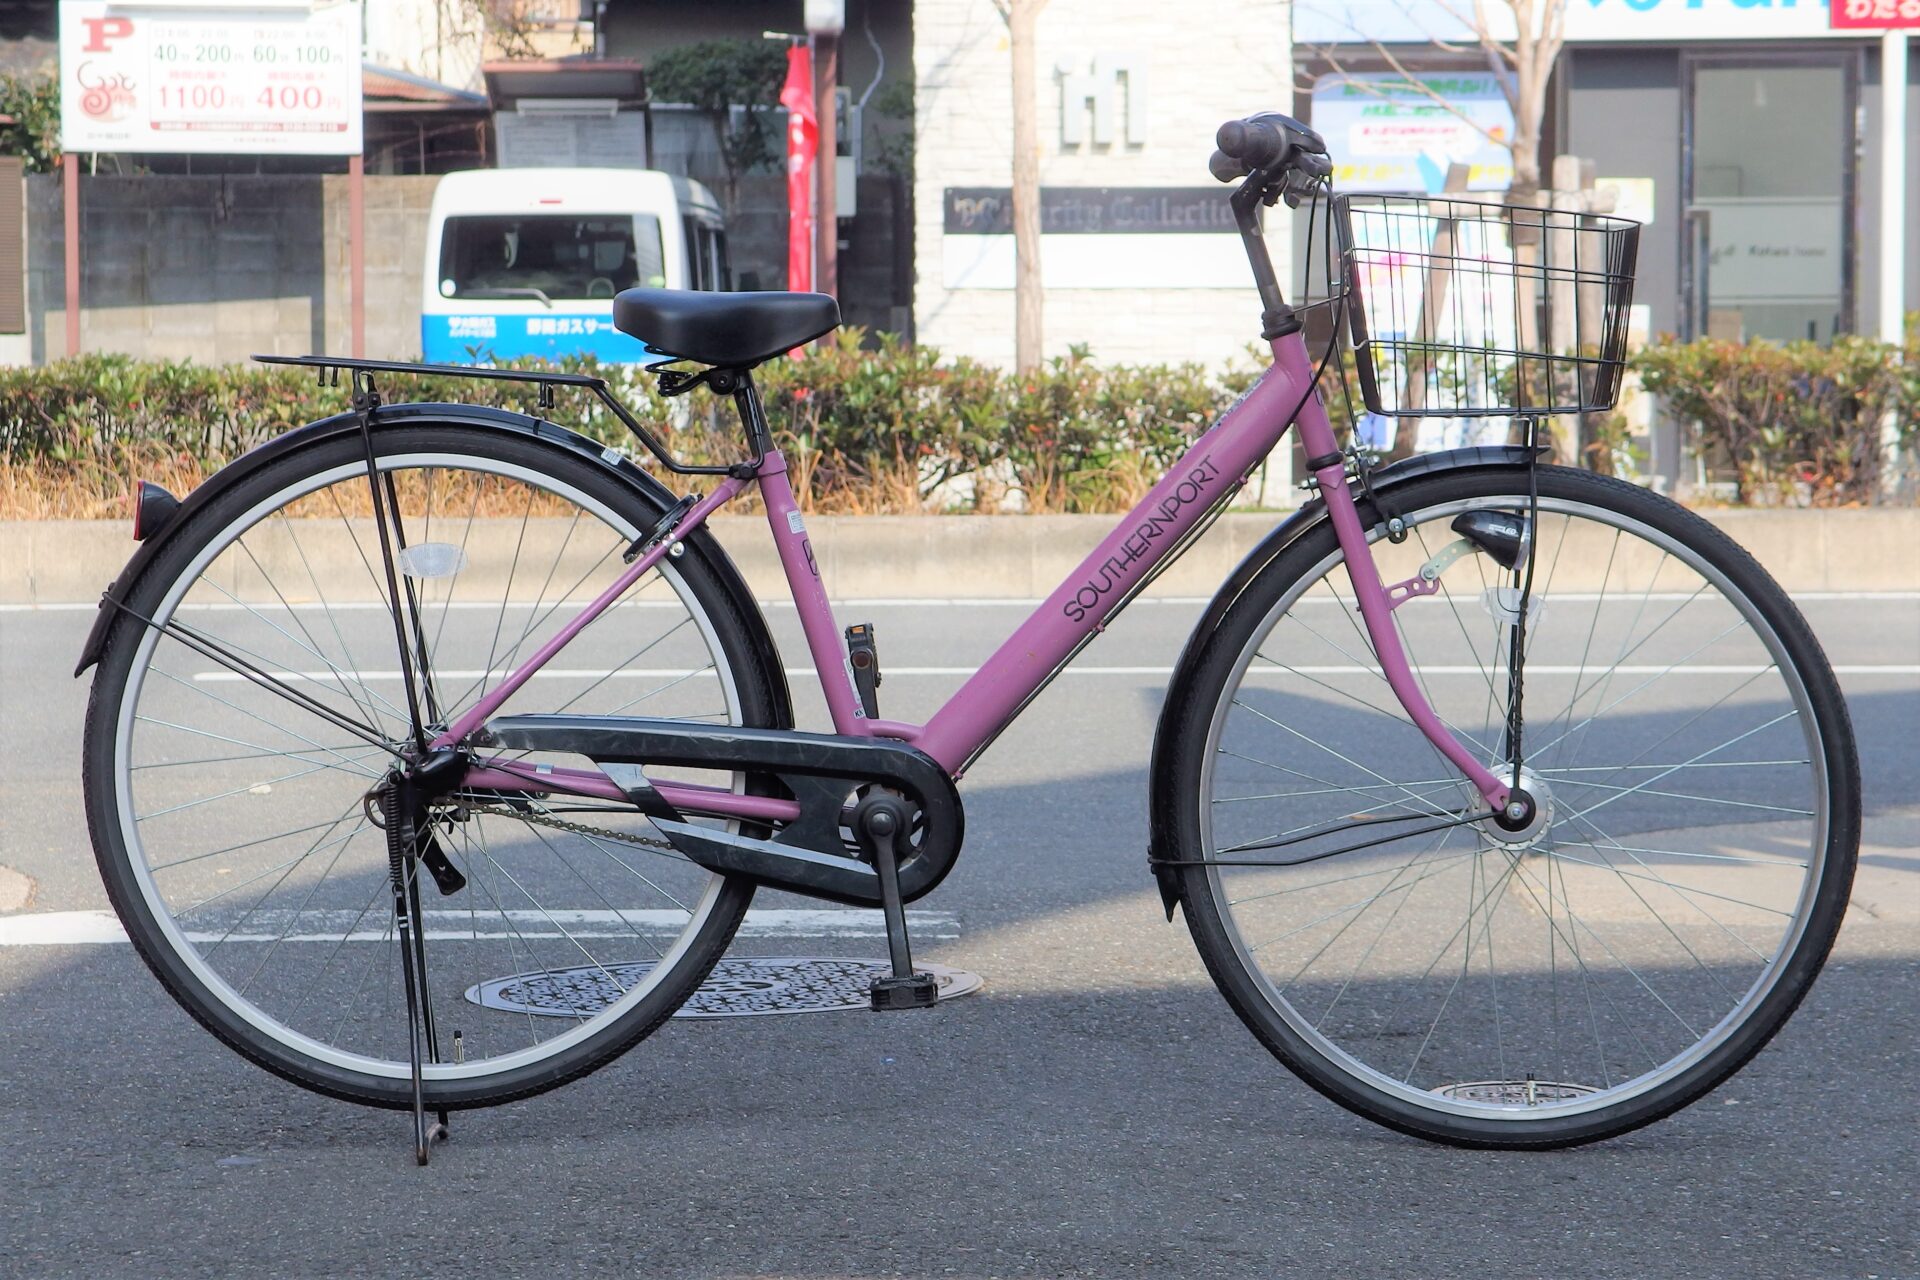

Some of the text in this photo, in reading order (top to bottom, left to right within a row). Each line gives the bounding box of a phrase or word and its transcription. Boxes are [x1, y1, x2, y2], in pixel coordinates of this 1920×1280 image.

[81, 16, 135, 53] P
[1110, 195, 1236, 226] Collectio
[1063, 455, 1220, 622] SOUTHERNPORT
